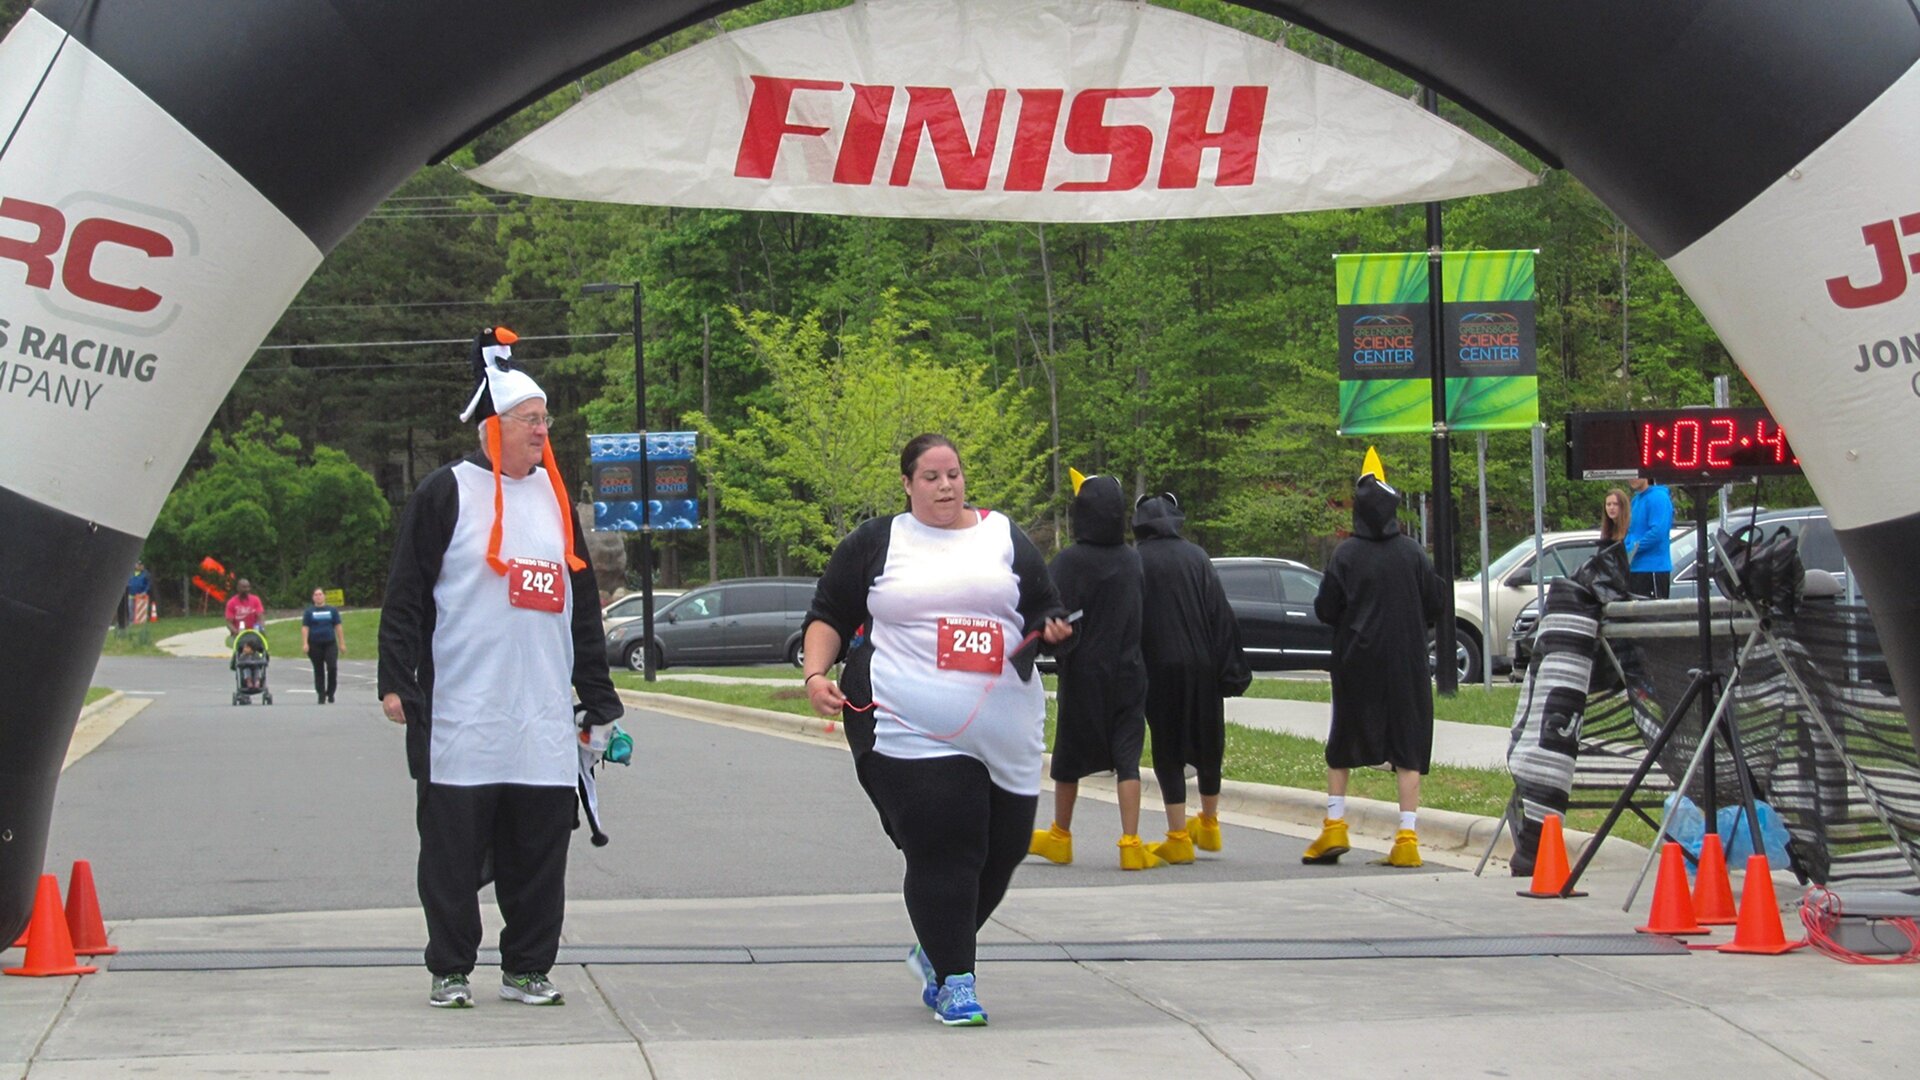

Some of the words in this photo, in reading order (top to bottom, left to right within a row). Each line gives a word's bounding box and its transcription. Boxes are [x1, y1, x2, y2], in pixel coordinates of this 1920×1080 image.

[734, 75, 1269, 191] FINISH
[1353, 336, 1414, 350] SCIENCE
[1459, 333, 1520, 347] SCIENCE
[19, 325, 158, 382] RACING
[1353, 349, 1414, 364] CENTER
[1459, 346, 1520, 361] CENTER
[0, 361, 104, 411] PANY
[522, 570, 554, 594] 242
[953, 629, 992, 654] 243
